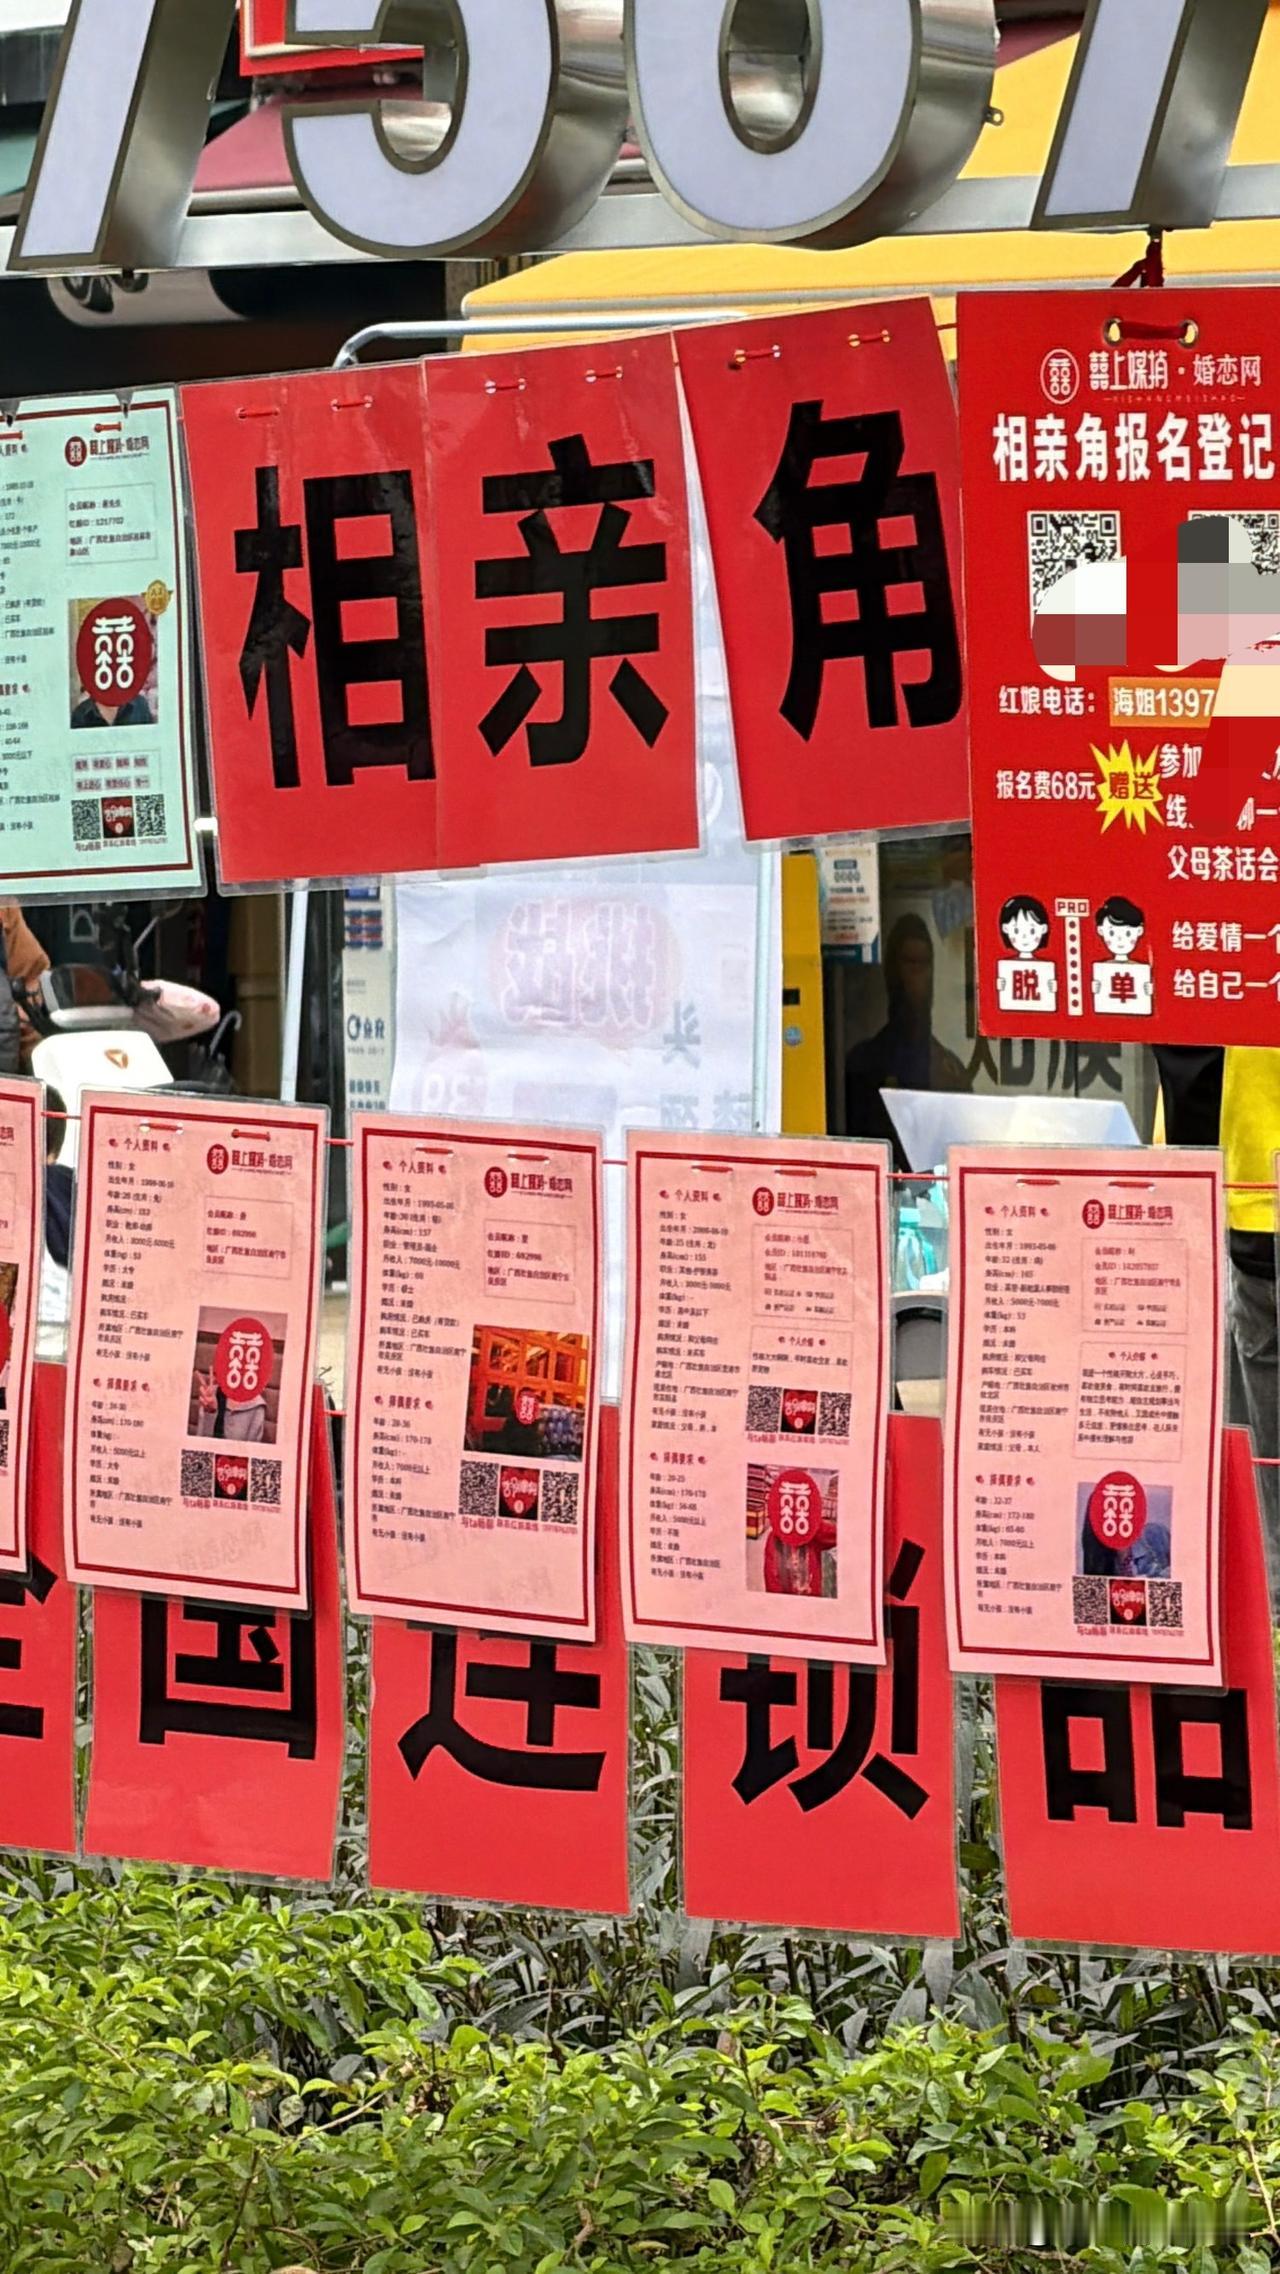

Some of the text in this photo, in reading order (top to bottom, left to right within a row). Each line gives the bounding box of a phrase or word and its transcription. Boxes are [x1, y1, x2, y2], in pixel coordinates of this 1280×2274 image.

[992, 411, 1277, 483] 相亲角报名登记
[998, 685, 1096, 715] 红娘电话：
[996, 770, 1097, 801] 报名费68元
[1108, 771, 1155, 801] 赠送
[1011, 969, 1138, 1004] 脱 单
